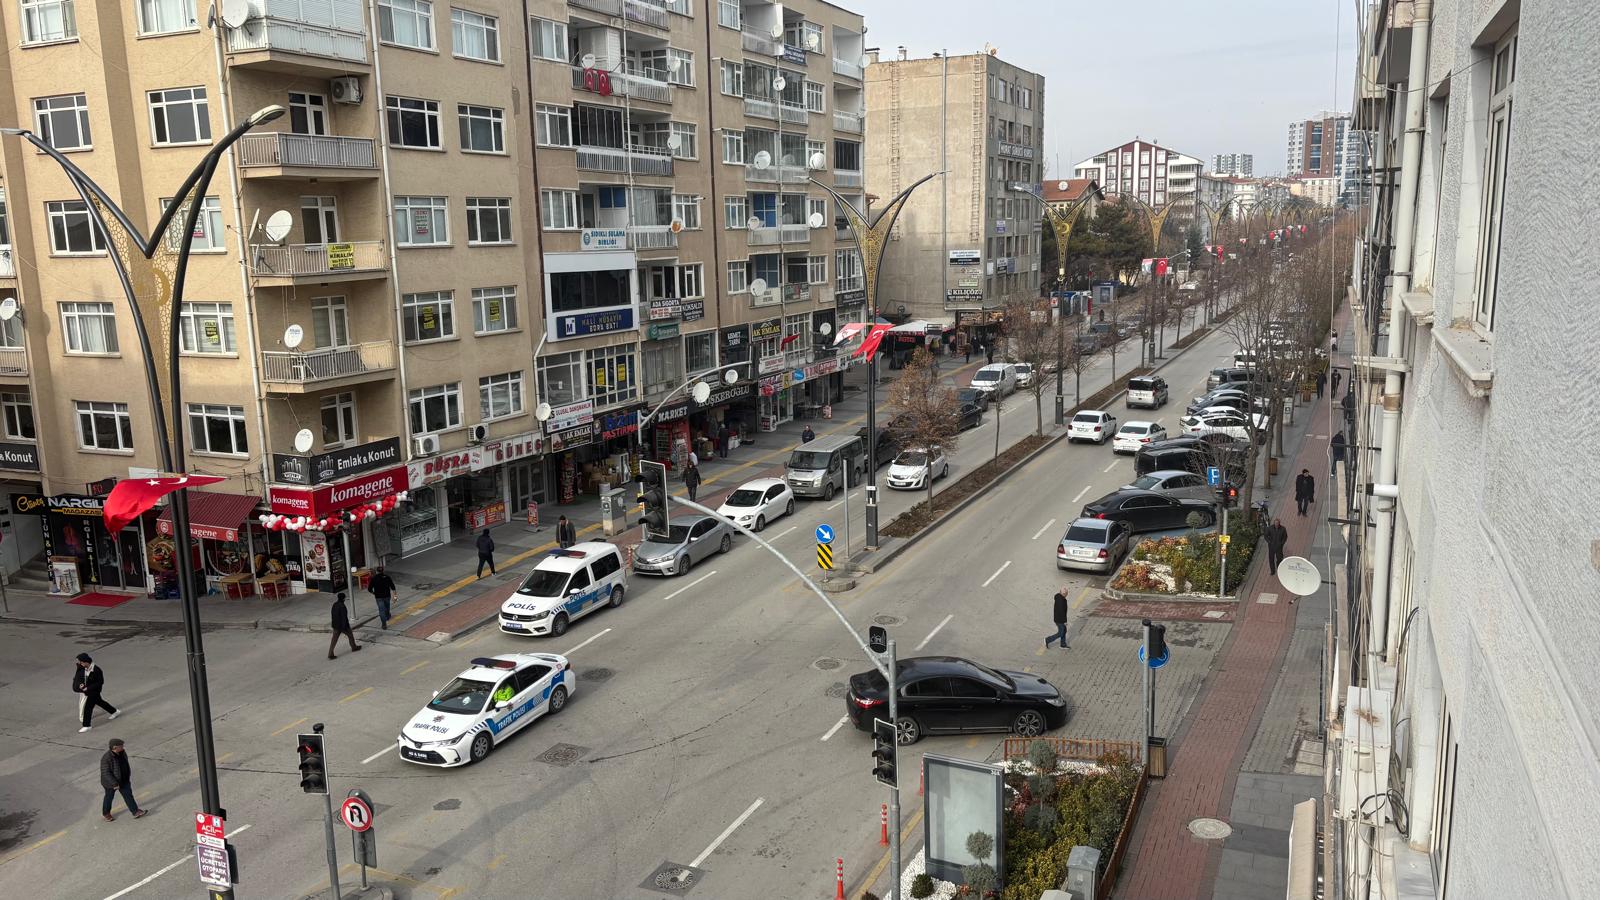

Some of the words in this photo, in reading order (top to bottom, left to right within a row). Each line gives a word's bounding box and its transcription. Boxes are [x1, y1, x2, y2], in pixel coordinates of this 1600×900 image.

[658, 406, 688, 422] MARKET
[4, 451, 33, 463] Konut
[337, 454, 362, 471] Emlak
[368, 446, 395, 462] Konut
[1211, 469, 1219, 484] P
[330, 476, 393, 503] komagene
[272, 494, 308, 507] komagene
[508, 602, 536, 611] POLİS
[202, 824, 216, 833] ACİL
[202, 865, 226, 876] OTOPARK
